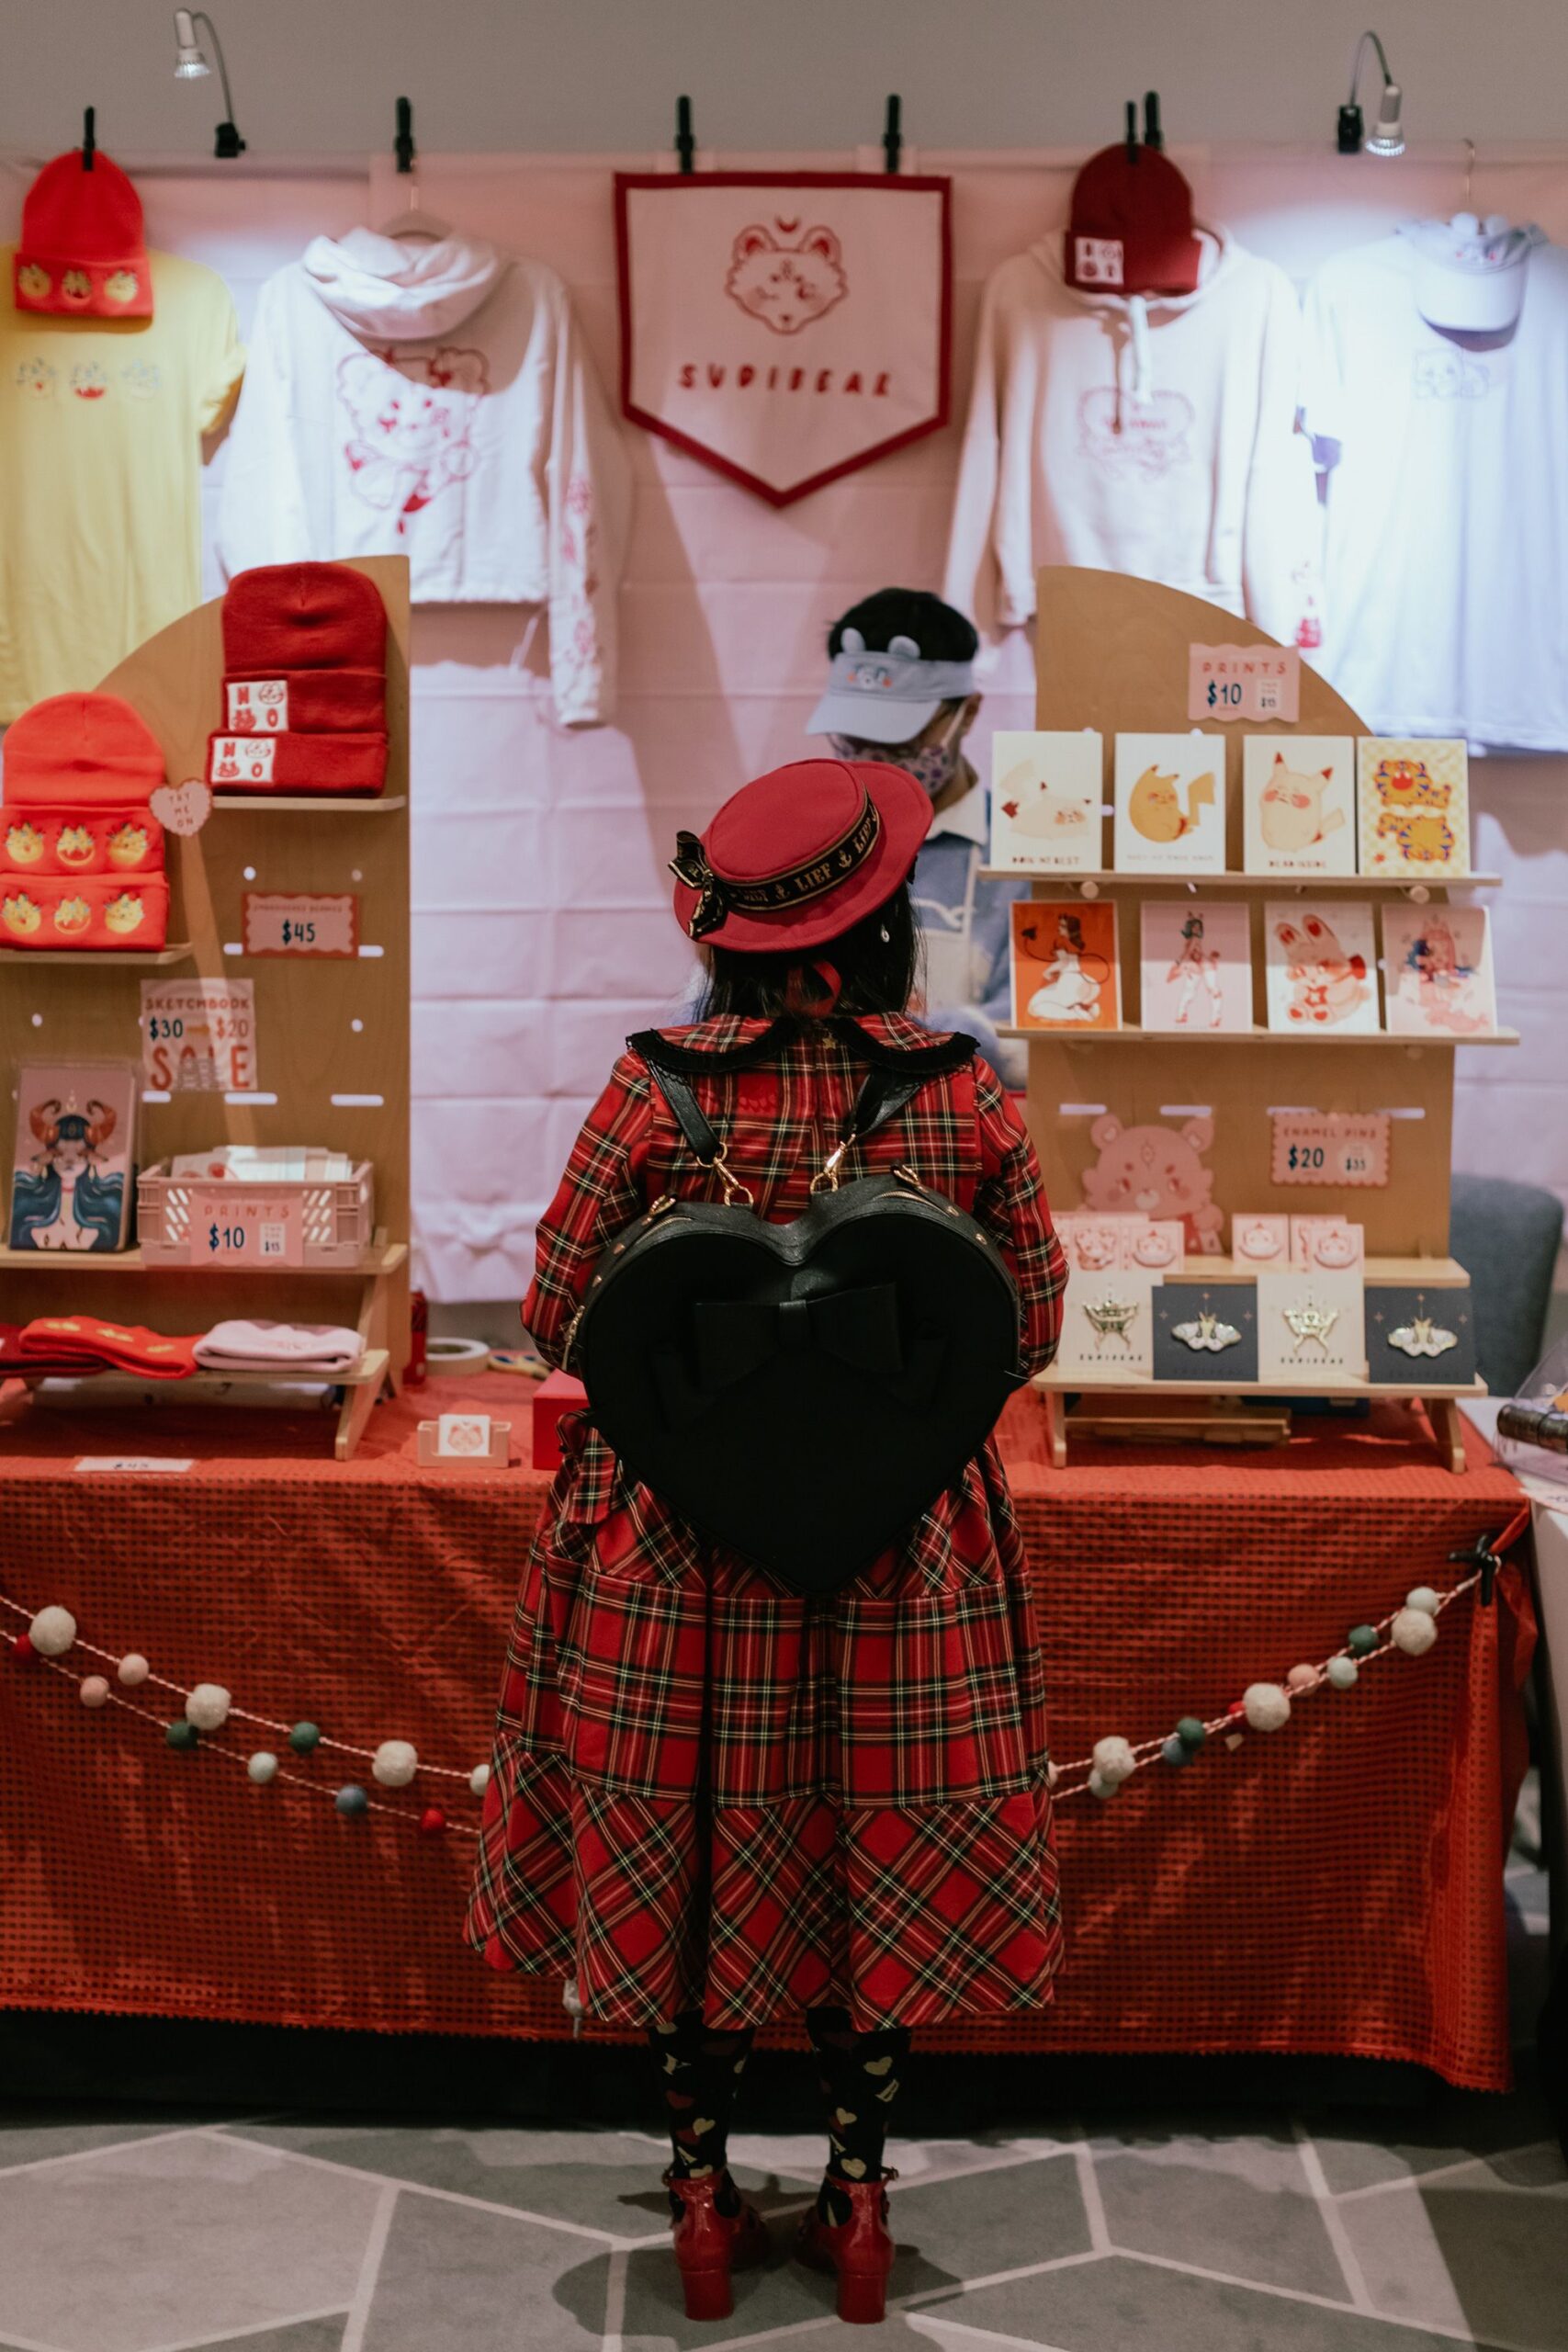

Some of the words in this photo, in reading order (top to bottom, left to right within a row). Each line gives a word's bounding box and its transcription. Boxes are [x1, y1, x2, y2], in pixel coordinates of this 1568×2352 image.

[1201, 661, 1287, 675] PRINTS
[1206, 678, 1242, 707] $10
[794, 862, 831, 893] LIEF
[282, 919, 316, 946] $45
[145, 998, 249, 1010] SKETCHBOOK
[149, 1015, 184, 1041] $30
[217, 1015, 249, 1040] $20
[1283, 1126, 1337, 1138] ENAMEL
[1288, 1142, 1325, 1171] $20
[204, 1204, 290, 1219] PRINTS
[208, 1223, 245, 1253] $10
